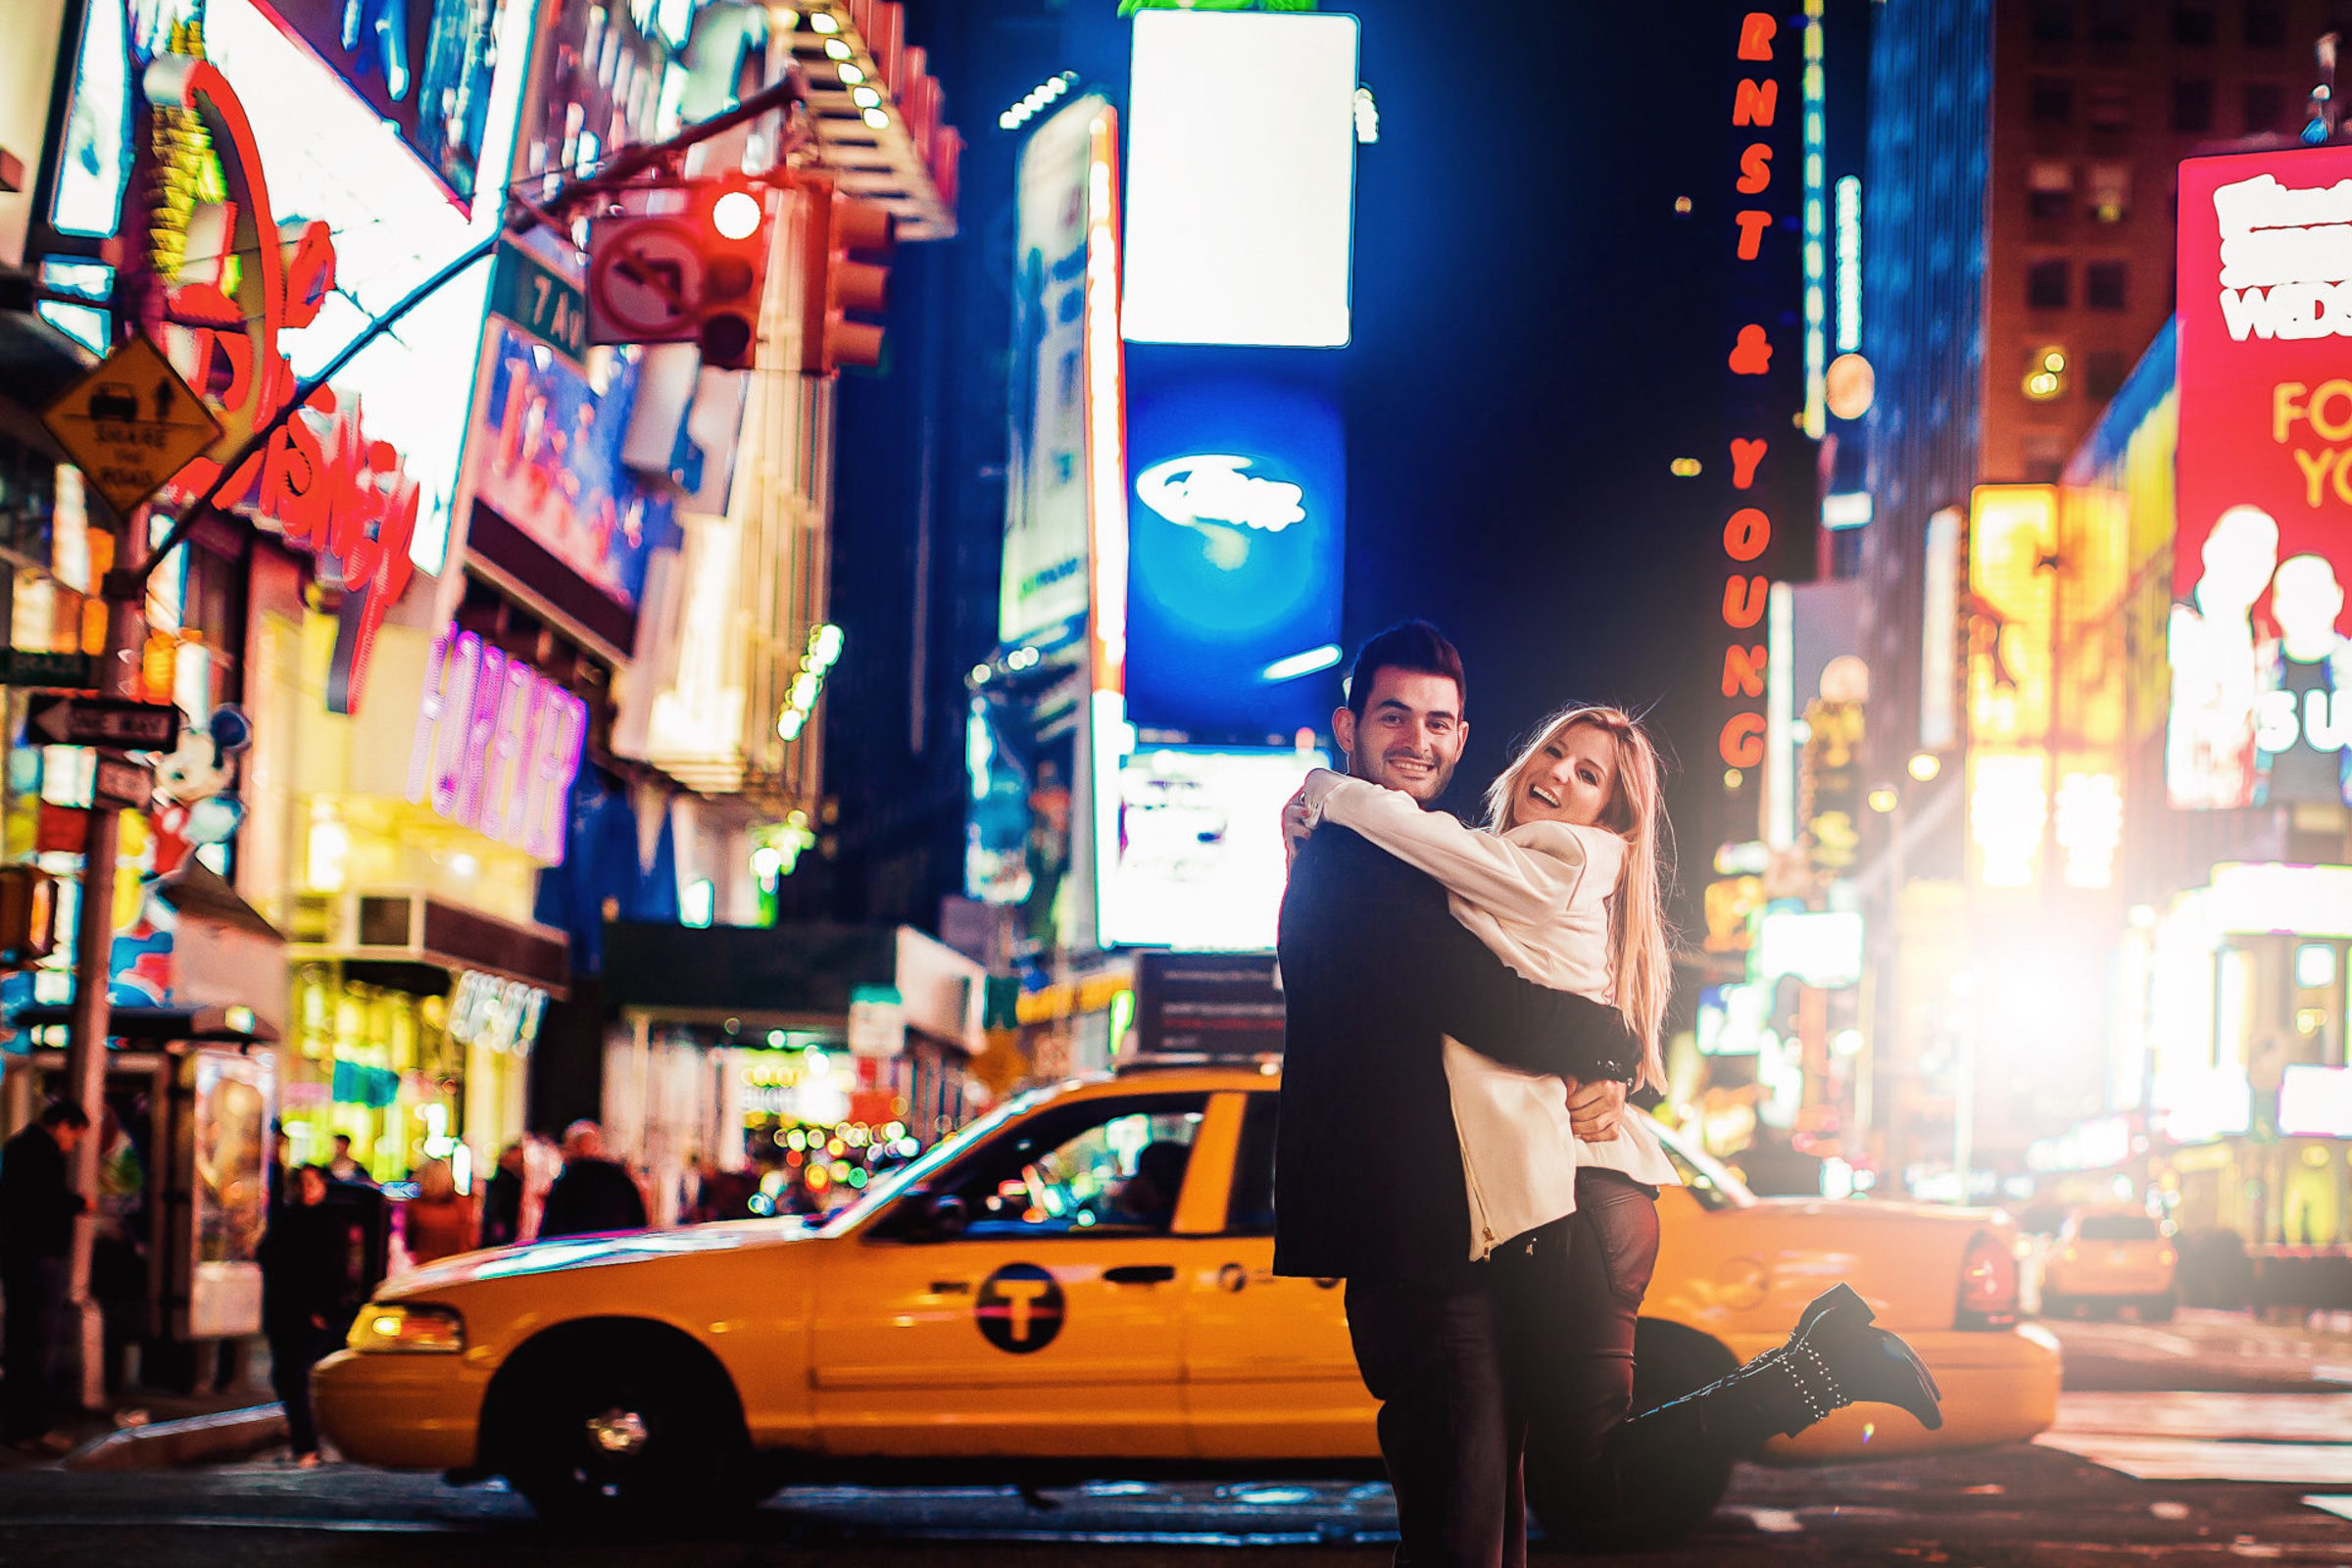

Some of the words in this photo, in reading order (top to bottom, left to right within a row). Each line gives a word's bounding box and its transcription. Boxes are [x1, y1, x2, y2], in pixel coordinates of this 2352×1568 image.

[533, 274, 552, 325] 7
[1729, 323, 1773, 374] &
[1719, 437, 1771, 768] YOUNG
[995, 1279, 1048, 1342] T
